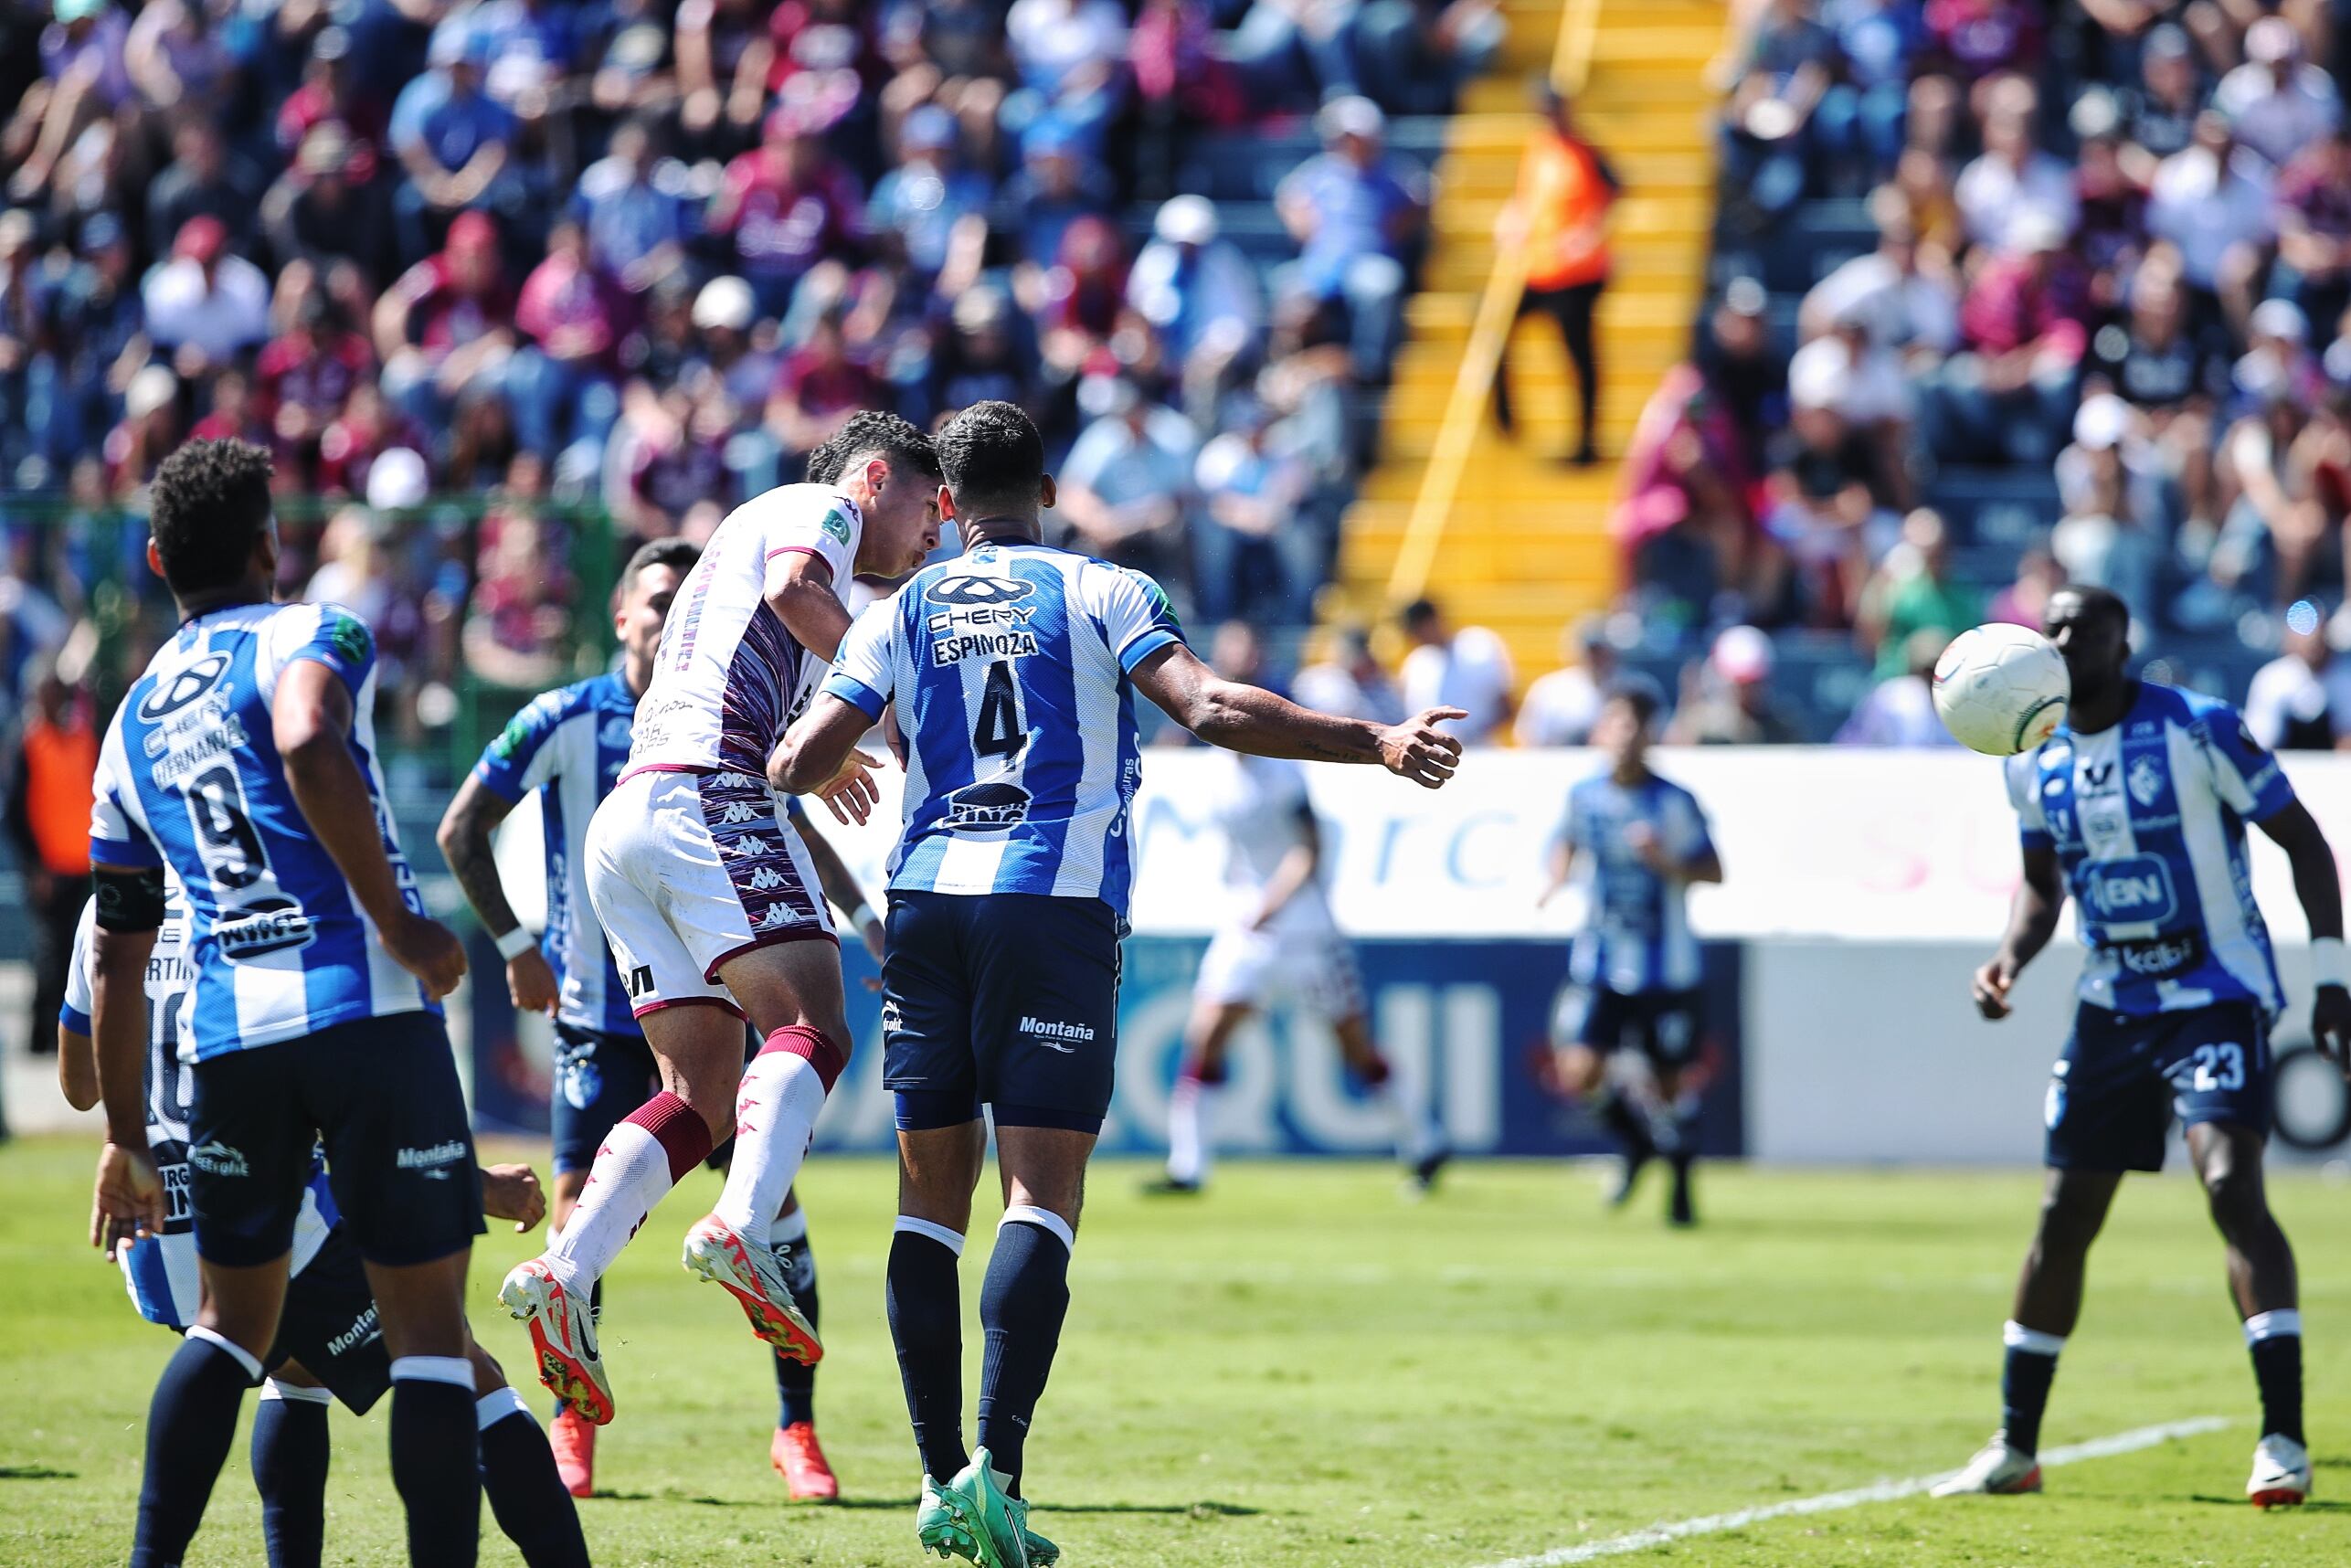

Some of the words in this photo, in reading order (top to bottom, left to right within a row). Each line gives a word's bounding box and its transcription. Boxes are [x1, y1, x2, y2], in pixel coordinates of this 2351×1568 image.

[928, 608, 1035, 632] CHERY
[933, 631, 1037, 665] ESPINOZA
[974, 660, 1028, 771] 4
[188, 766, 267, 891] 9
[1019, 1016, 1095, 1041] Montaña
[2193, 1042, 2245, 1093] 23
